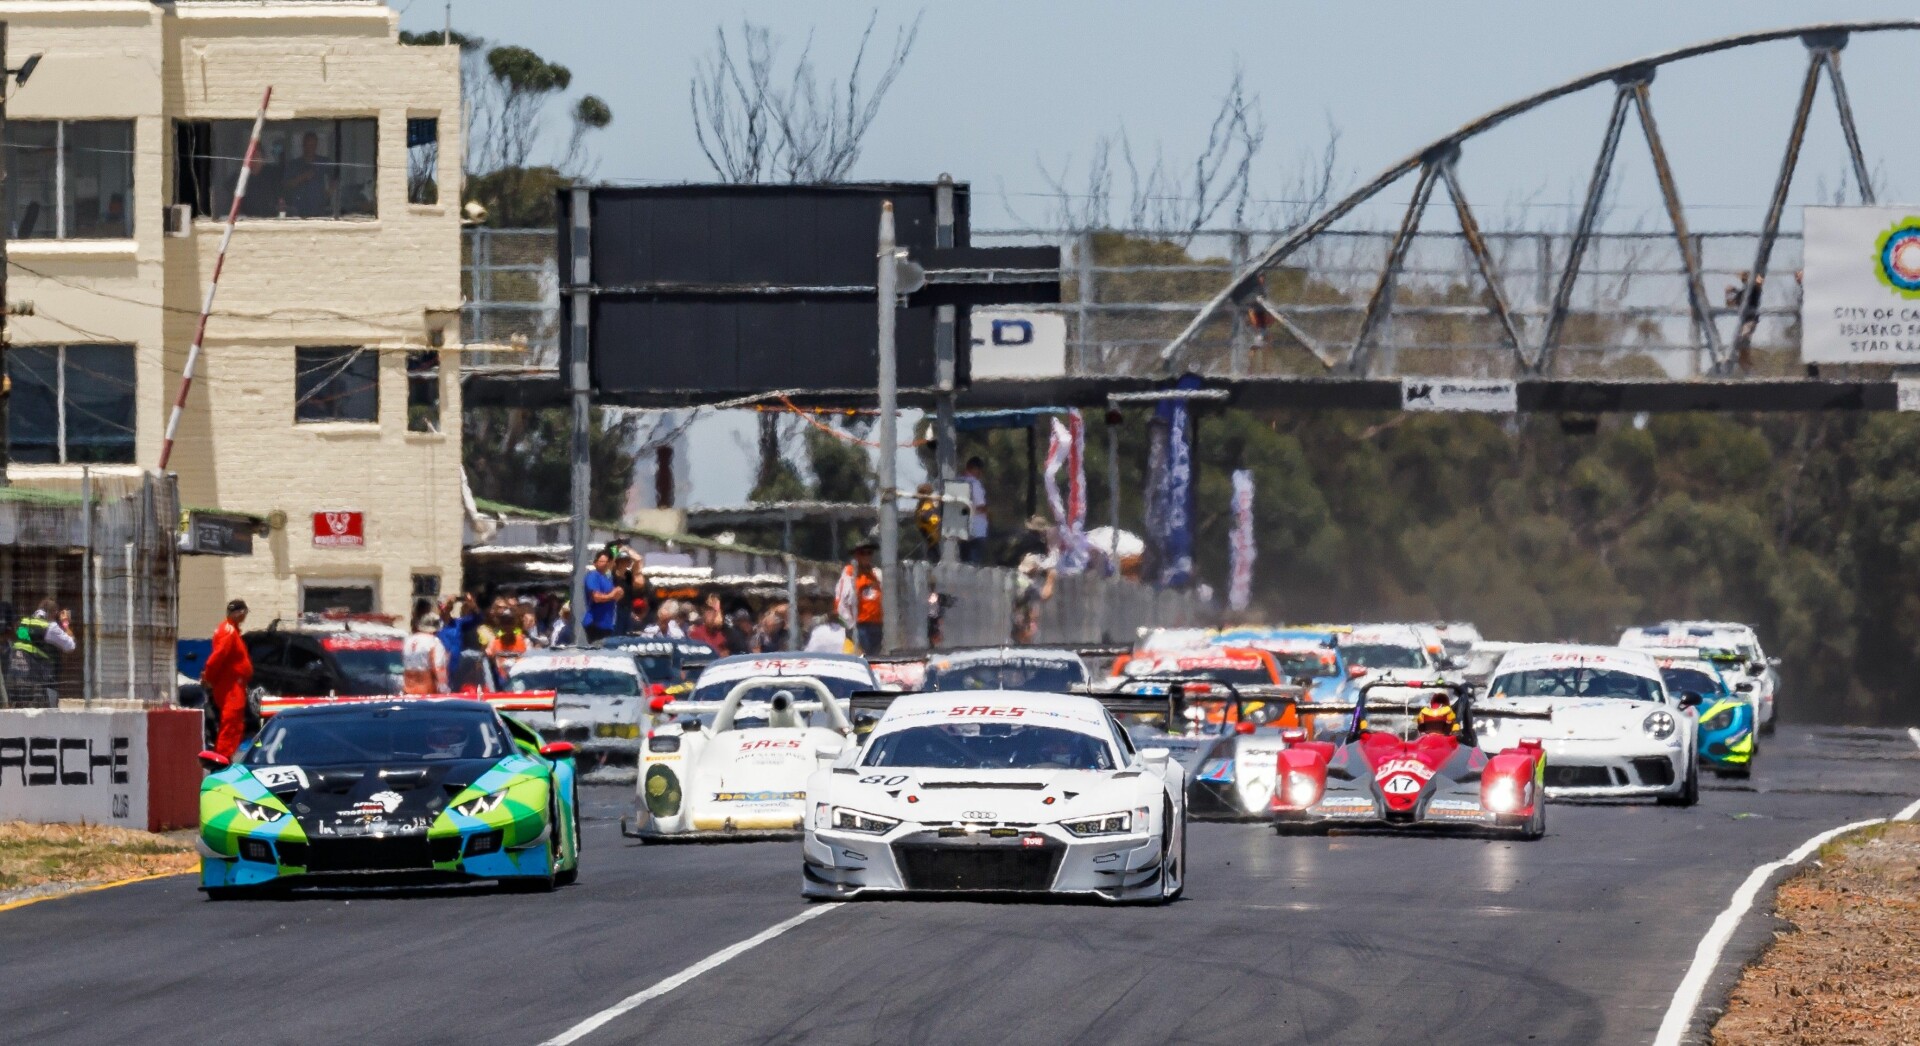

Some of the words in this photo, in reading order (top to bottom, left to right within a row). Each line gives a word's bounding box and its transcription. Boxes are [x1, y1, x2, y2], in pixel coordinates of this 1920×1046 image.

[1834, 307, 1867, 319] CITY
[1873, 308, 1893, 320] OF
[1851, 341, 1888, 352] STAD
[859, 775, 909, 785] 80
[1389, 778, 1413, 791] 17
[1024, 837, 1044, 846] TOW
